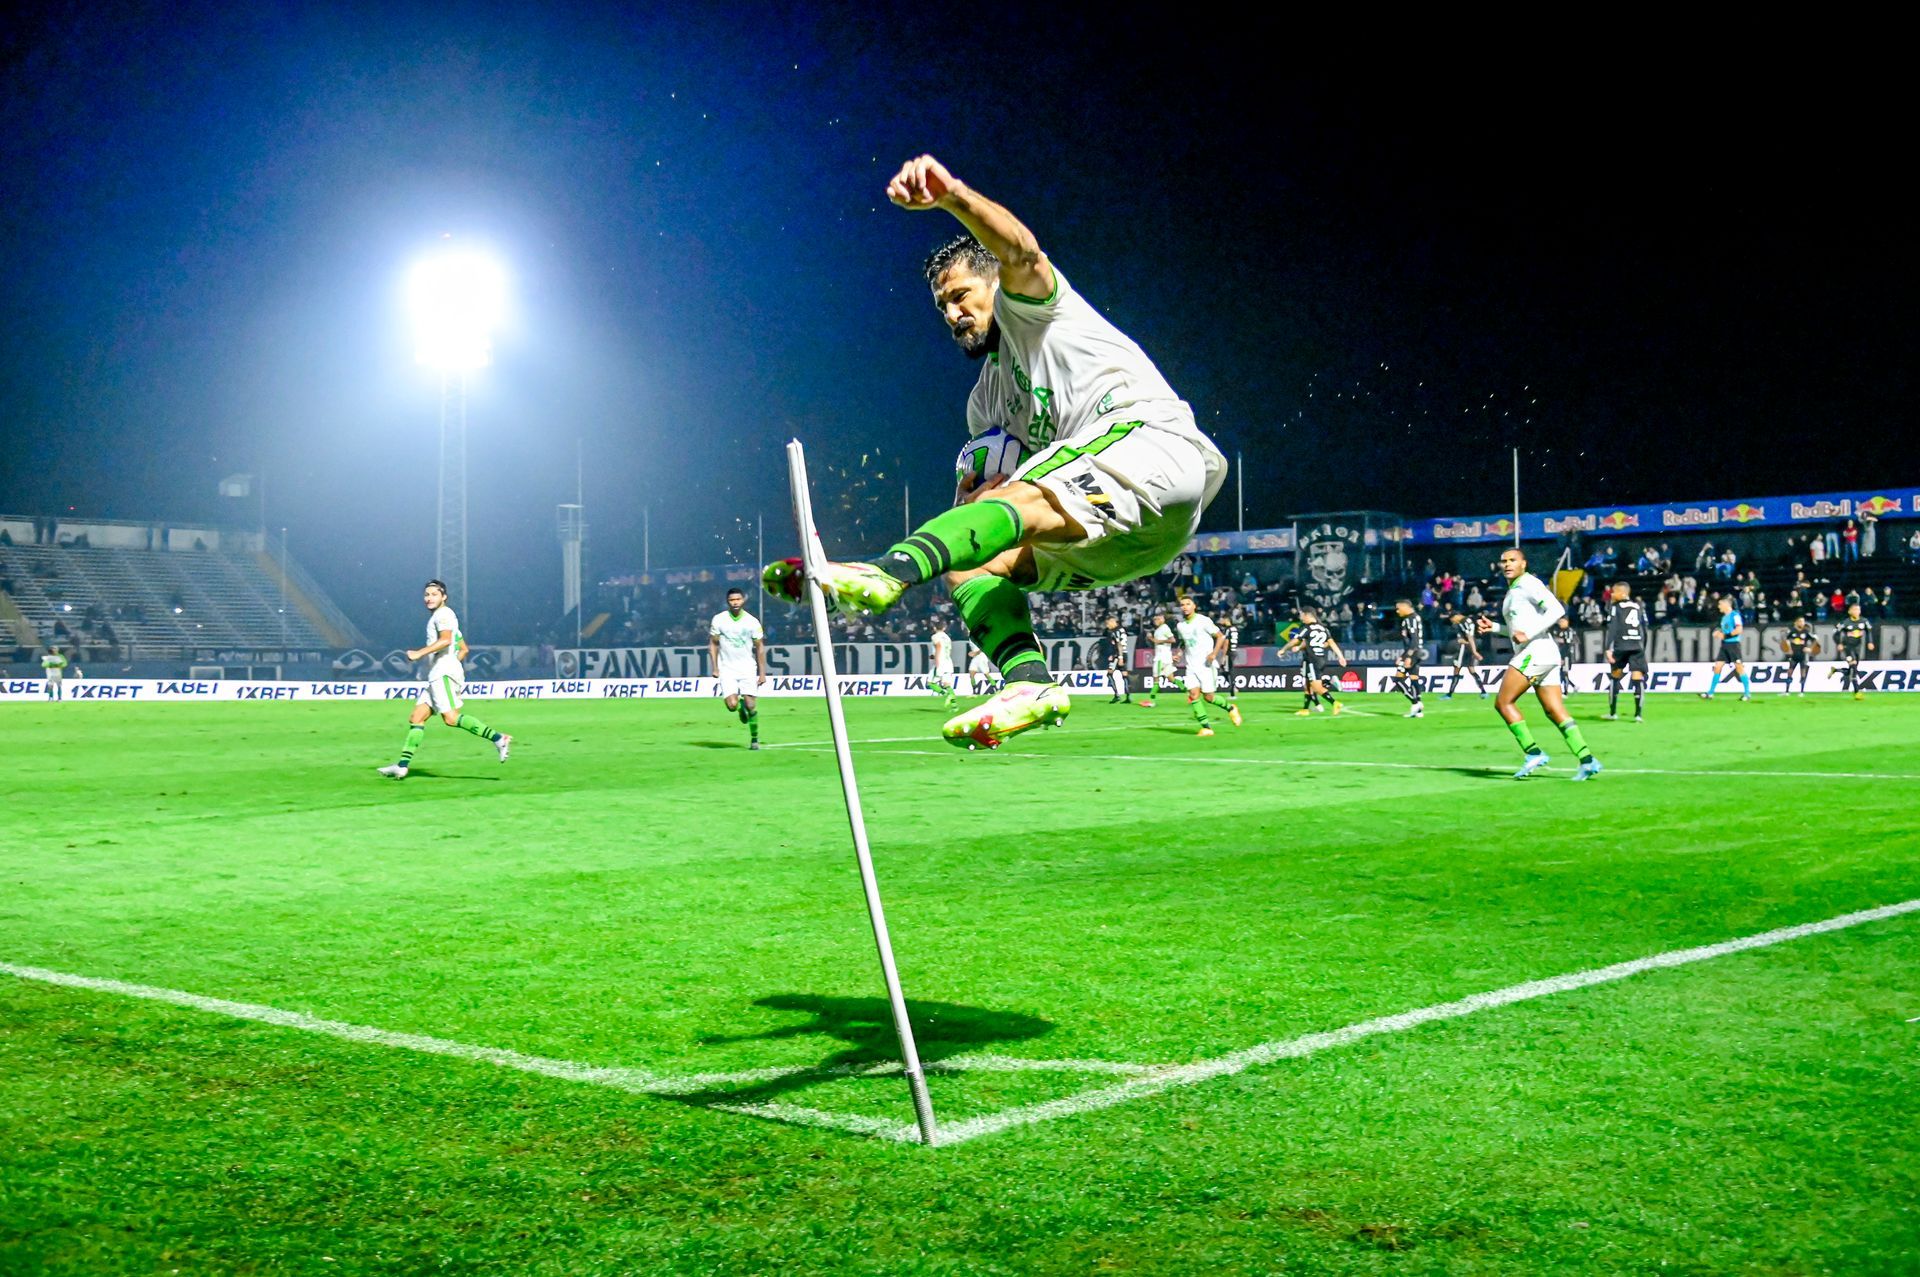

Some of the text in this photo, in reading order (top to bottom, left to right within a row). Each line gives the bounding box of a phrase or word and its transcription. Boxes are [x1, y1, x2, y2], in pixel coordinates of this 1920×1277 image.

[1663, 506, 1719, 526] RedBull
[1625, 608, 1640, 628] 4
[1309, 630, 1328, 648] 22
[1358, 649, 1378, 661] ABI
[1248, 674, 1286, 688] ASSAÍ
